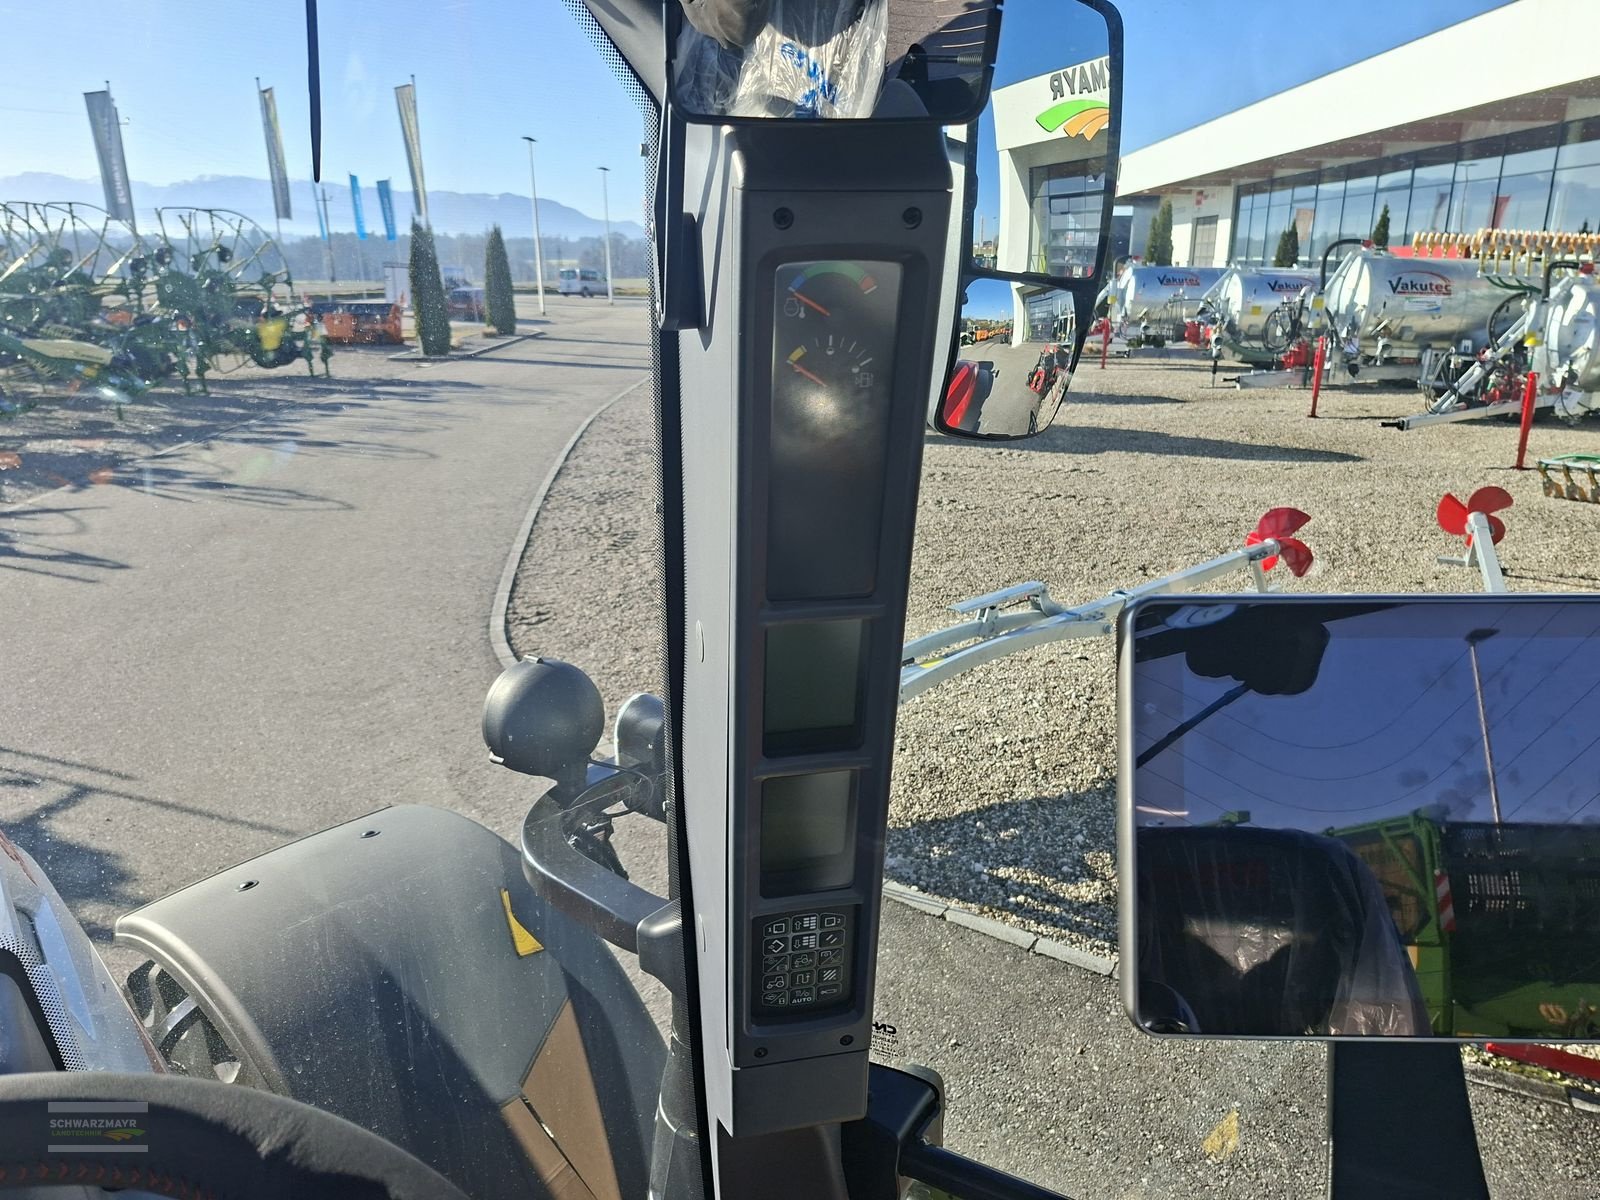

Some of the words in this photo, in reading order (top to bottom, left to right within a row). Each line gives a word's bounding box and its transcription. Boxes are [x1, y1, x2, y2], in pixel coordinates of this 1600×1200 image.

[1267, 280, 1308, 291] Vakut
[1388, 276, 1452, 294] Vakutec
[791, 996, 812, 1004] AUTO
